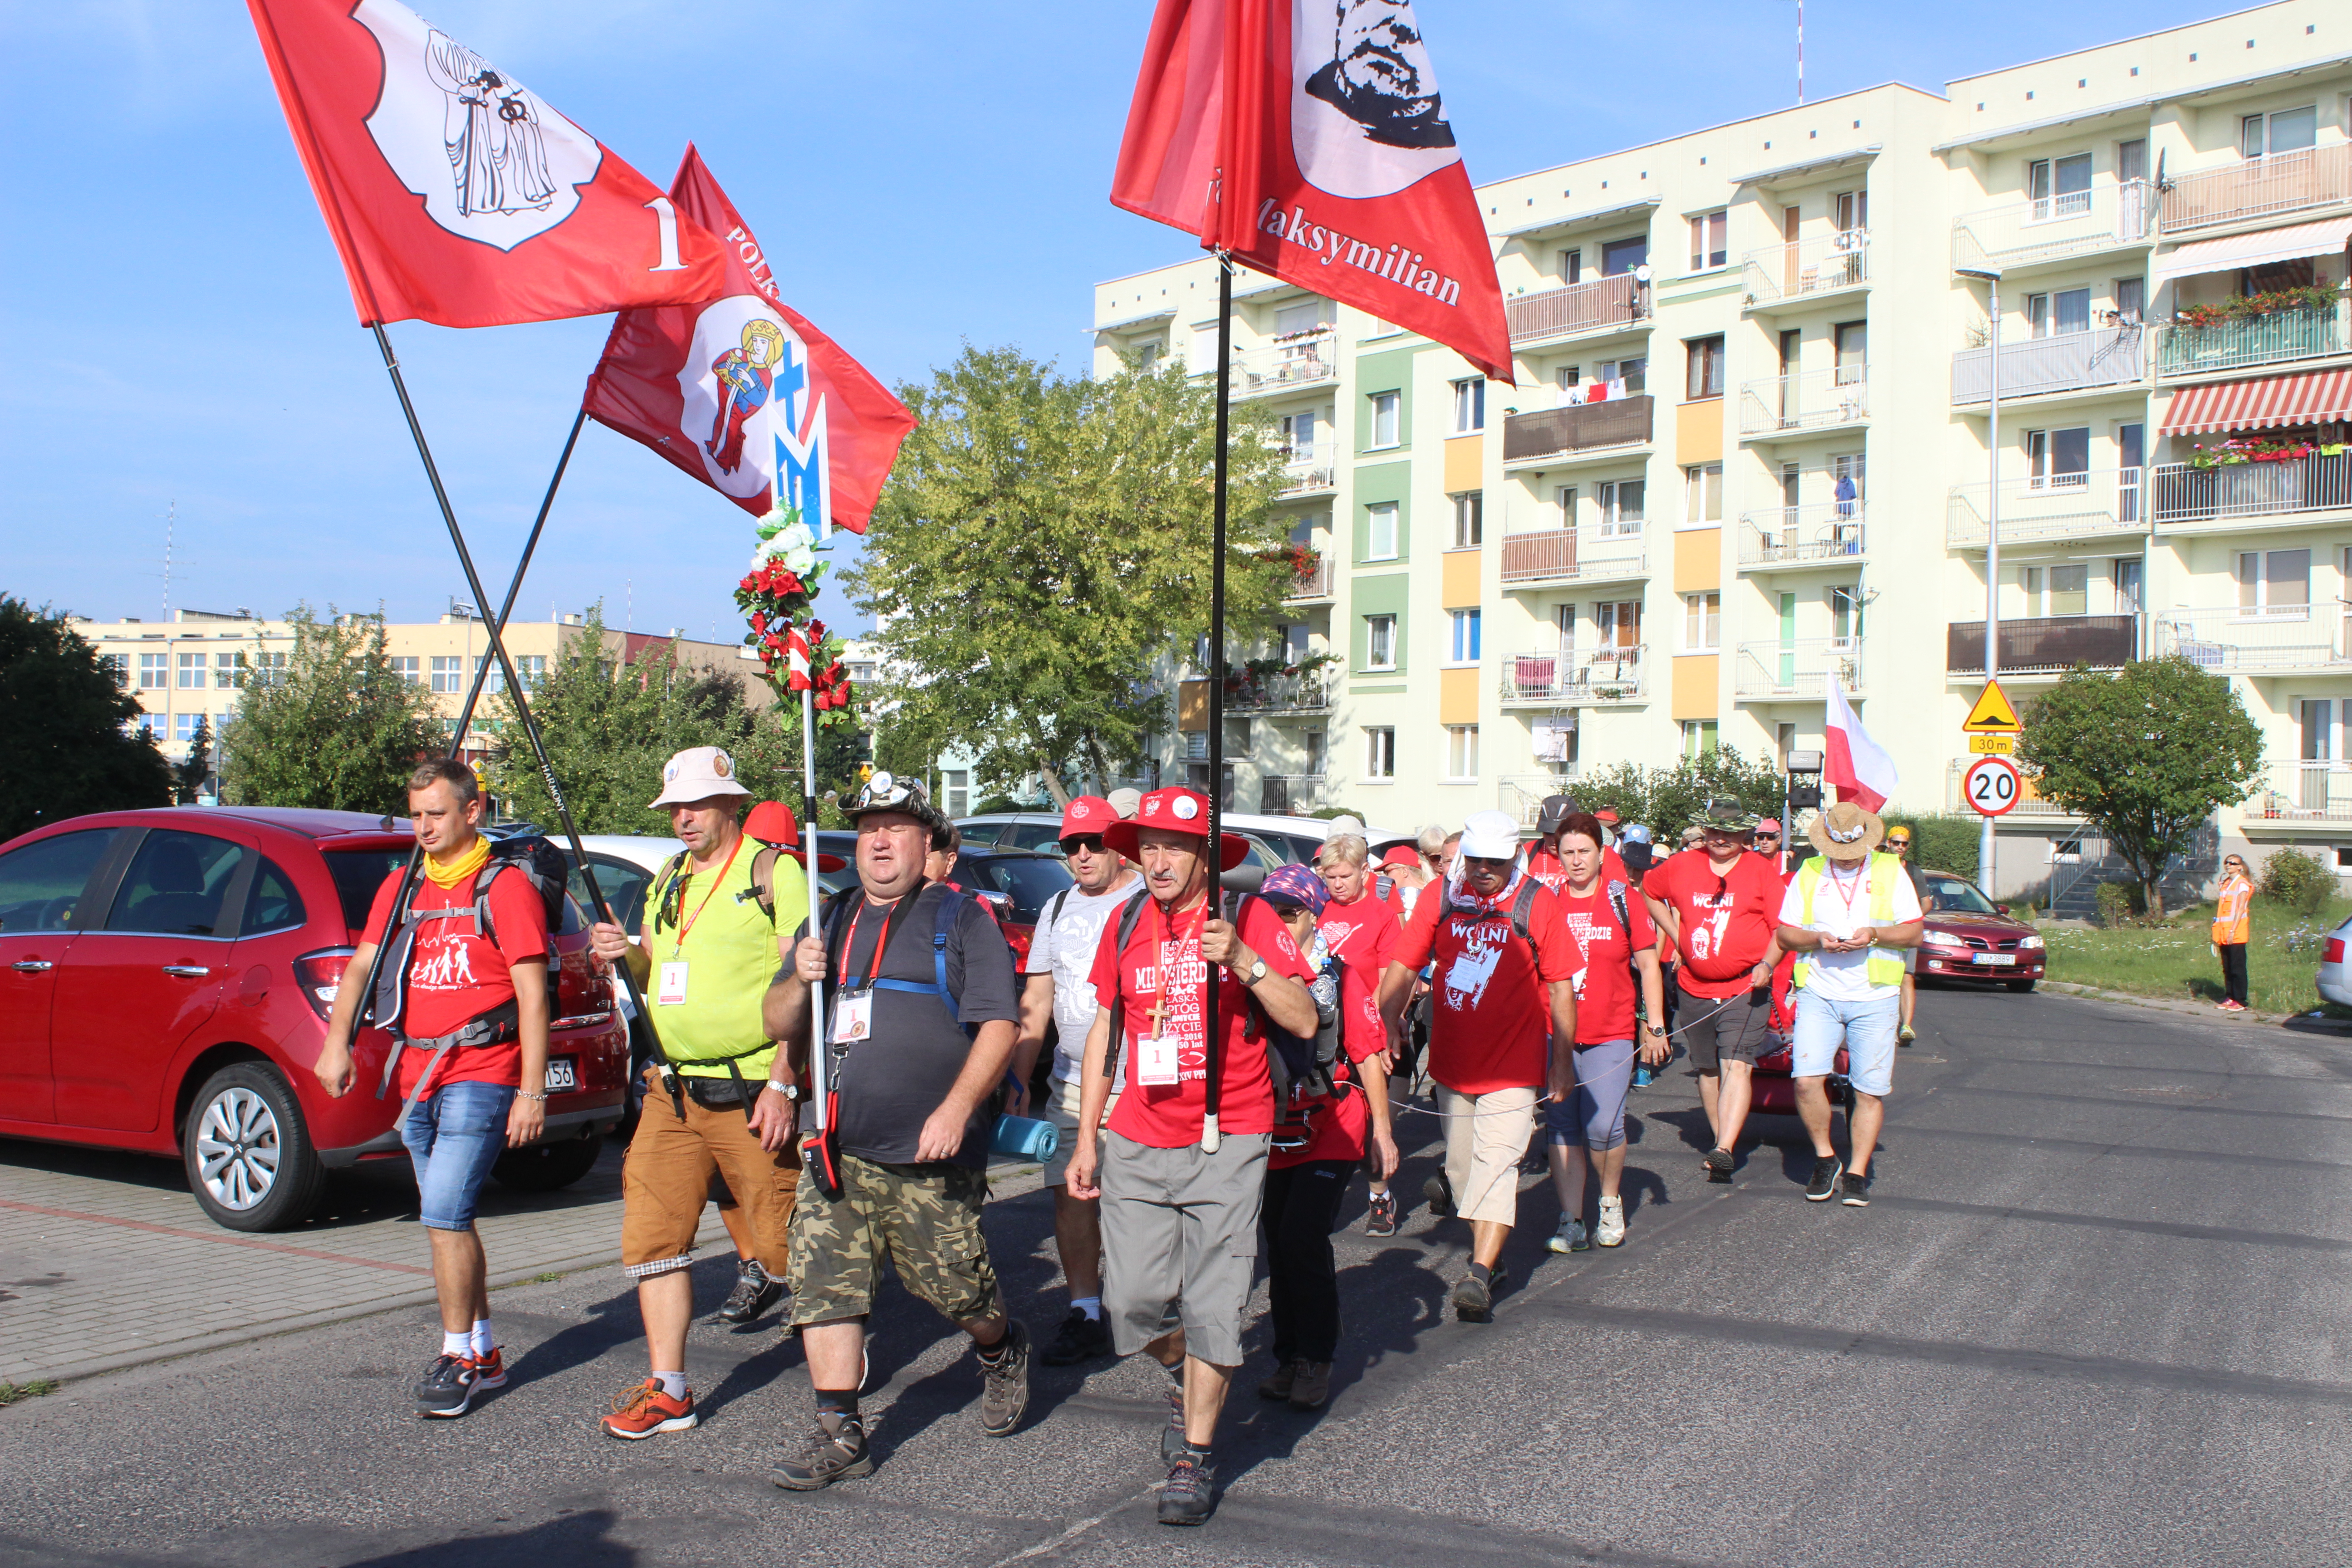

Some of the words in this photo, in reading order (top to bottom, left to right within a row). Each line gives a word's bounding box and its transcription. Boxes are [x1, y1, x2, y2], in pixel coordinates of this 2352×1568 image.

[643, 196, 689, 271] 1
[1979, 739, 1994, 750] 30
[541, 764, 566, 813] HARMONY
[1975, 774, 2013, 799] 20
[671, 972, 675, 985] 1
[1136, 961, 1228, 990] MIŁOSIERDE
[850, 1009, 857, 1022] 1
[1166, 1021, 1202, 1033] ŻYCIE
[1191, 1040, 1204, 1049] lat
[1154, 1049, 1161, 1063] 1
